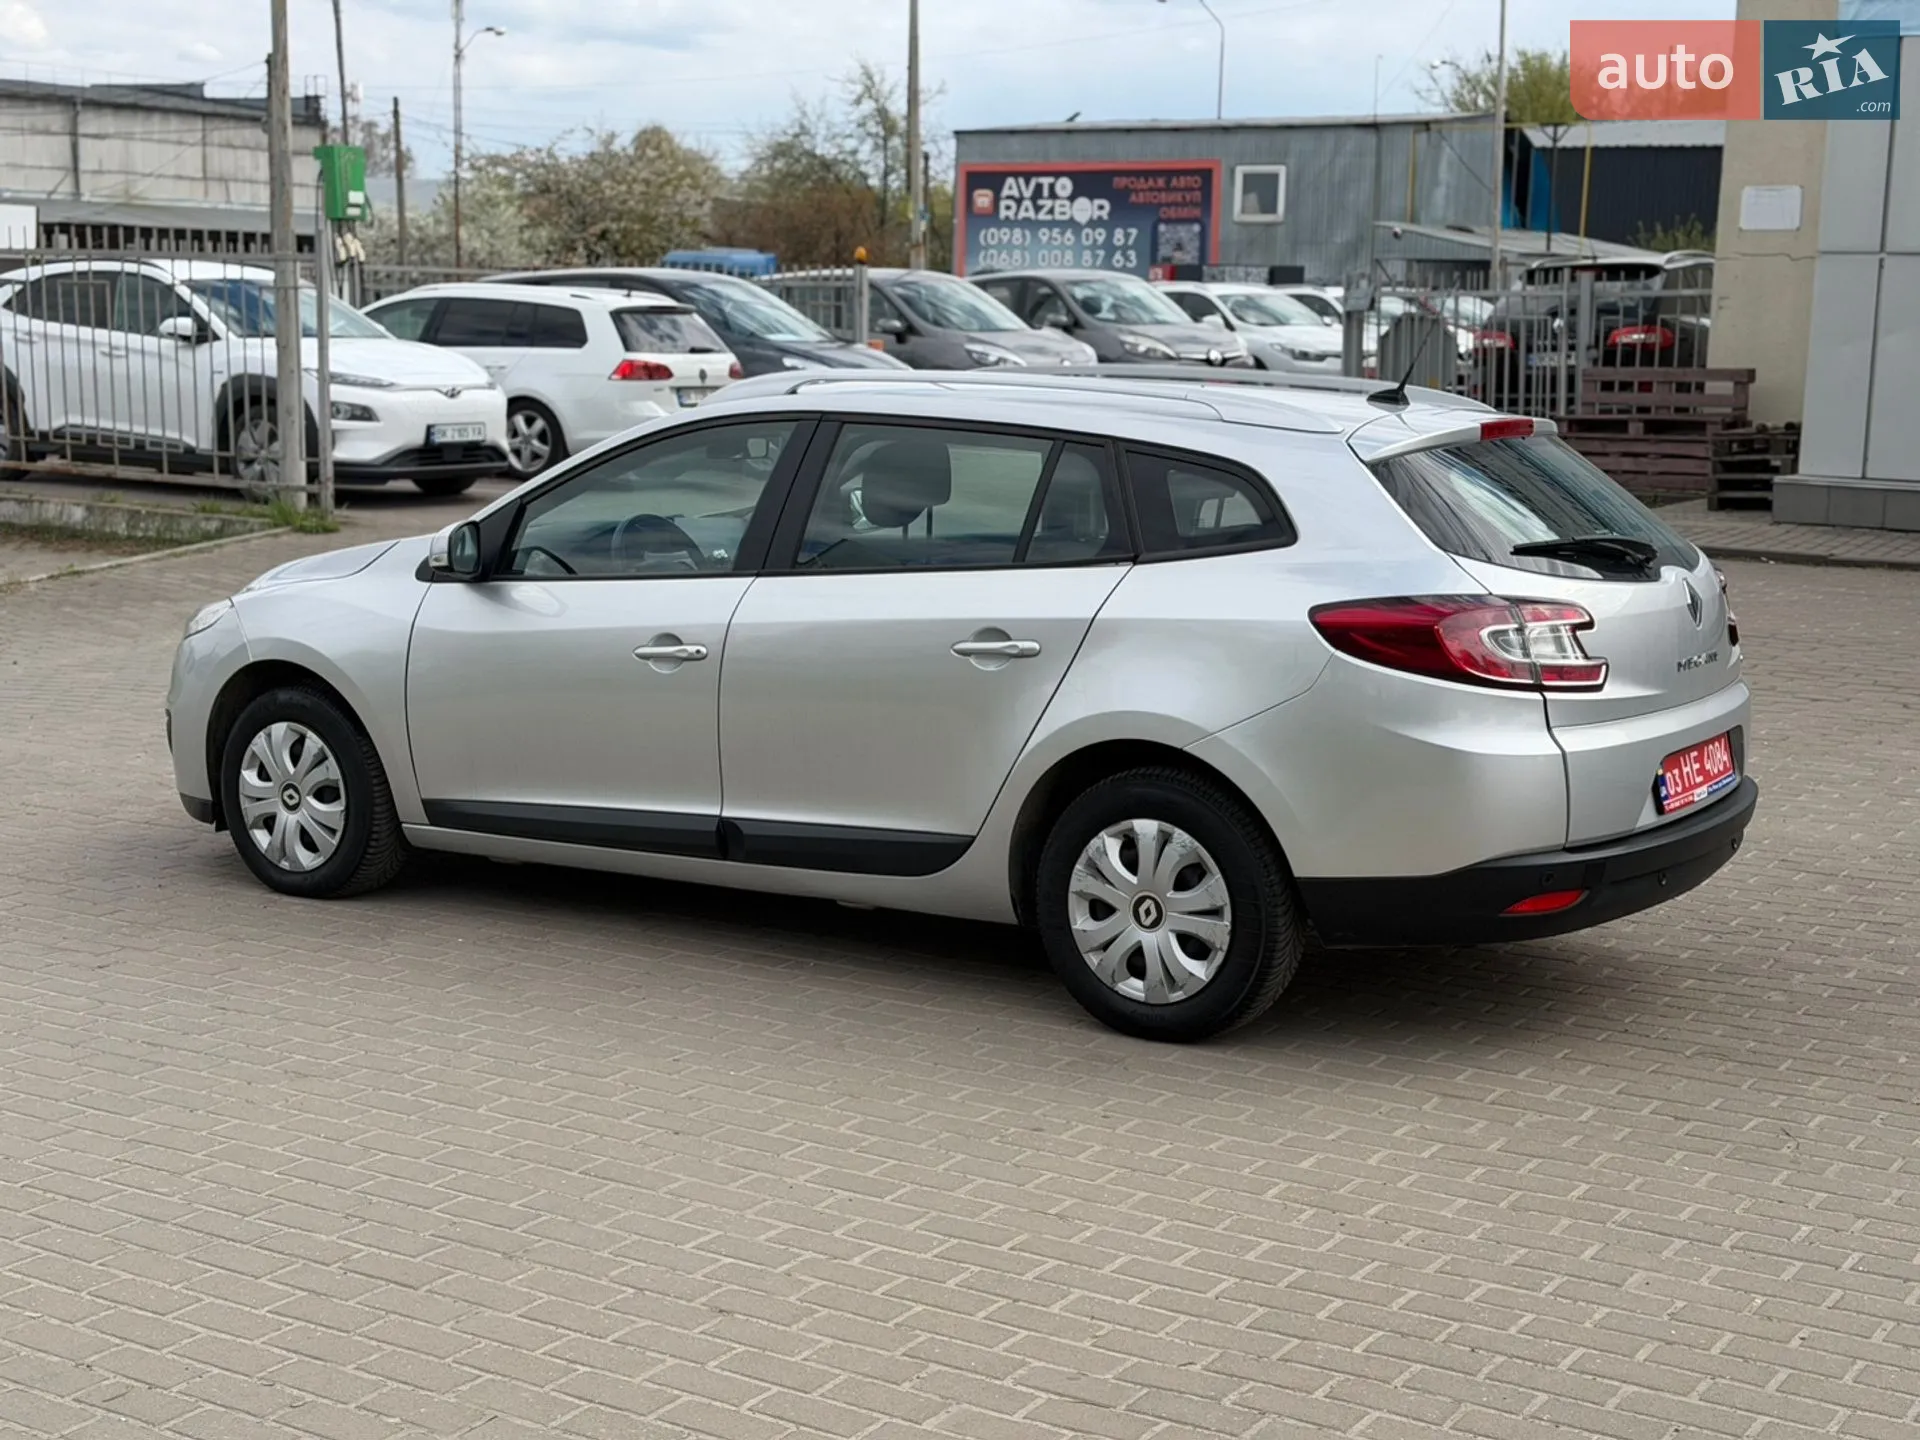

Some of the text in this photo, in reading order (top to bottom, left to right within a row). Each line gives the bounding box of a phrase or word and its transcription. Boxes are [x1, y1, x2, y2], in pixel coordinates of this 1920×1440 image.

[1000, 176, 1074, 199] AVTO
[1112, 175, 1202, 190] ПРОДАЖ АВТО
[1129, 190, 1202, 204] АВТОВИКУП
[998, 197, 1111, 224] RAZBOR
[978, 227, 1139, 247] (098) 956 09 87
[1037, 250, 1075, 268] 008
[1081, 250, 1105, 268] 87
[1112, 250, 1138, 268] 63
[1665, 768, 1683, 796] 03
[1680, 751, 1704, 789] HE
[1703, 738, 1730, 777] 4084
